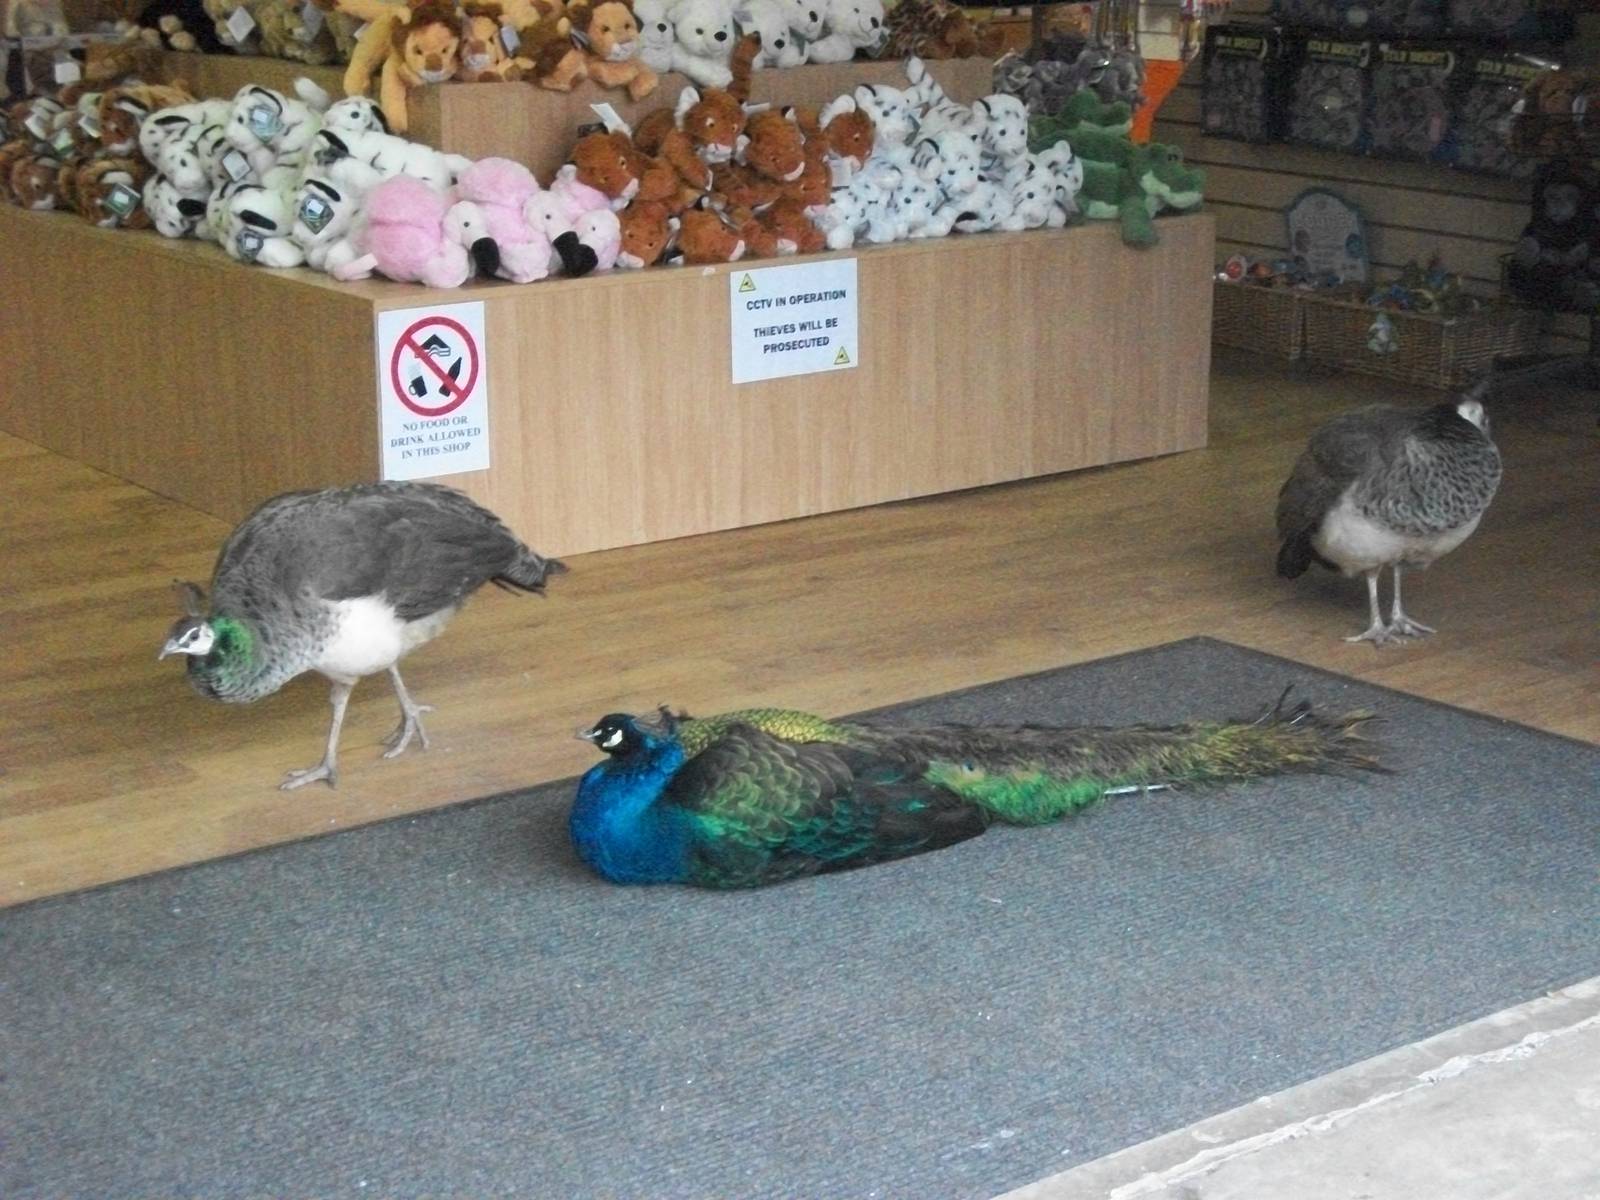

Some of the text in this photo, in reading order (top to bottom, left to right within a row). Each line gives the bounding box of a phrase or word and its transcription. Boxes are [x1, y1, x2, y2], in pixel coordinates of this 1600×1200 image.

[746, 289, 847, 311] CCTV IN OPERATION
[753, 317, 838, 338] THIEVES WILL BE
[763, 336, 830, 354] PROSECUTED
[403, 415, 468, 432] NO FOOD OR
[390, 427, 481, 448] DRINK ALLOWED
[401, 441, 471, 460] IN THIS SHOP
